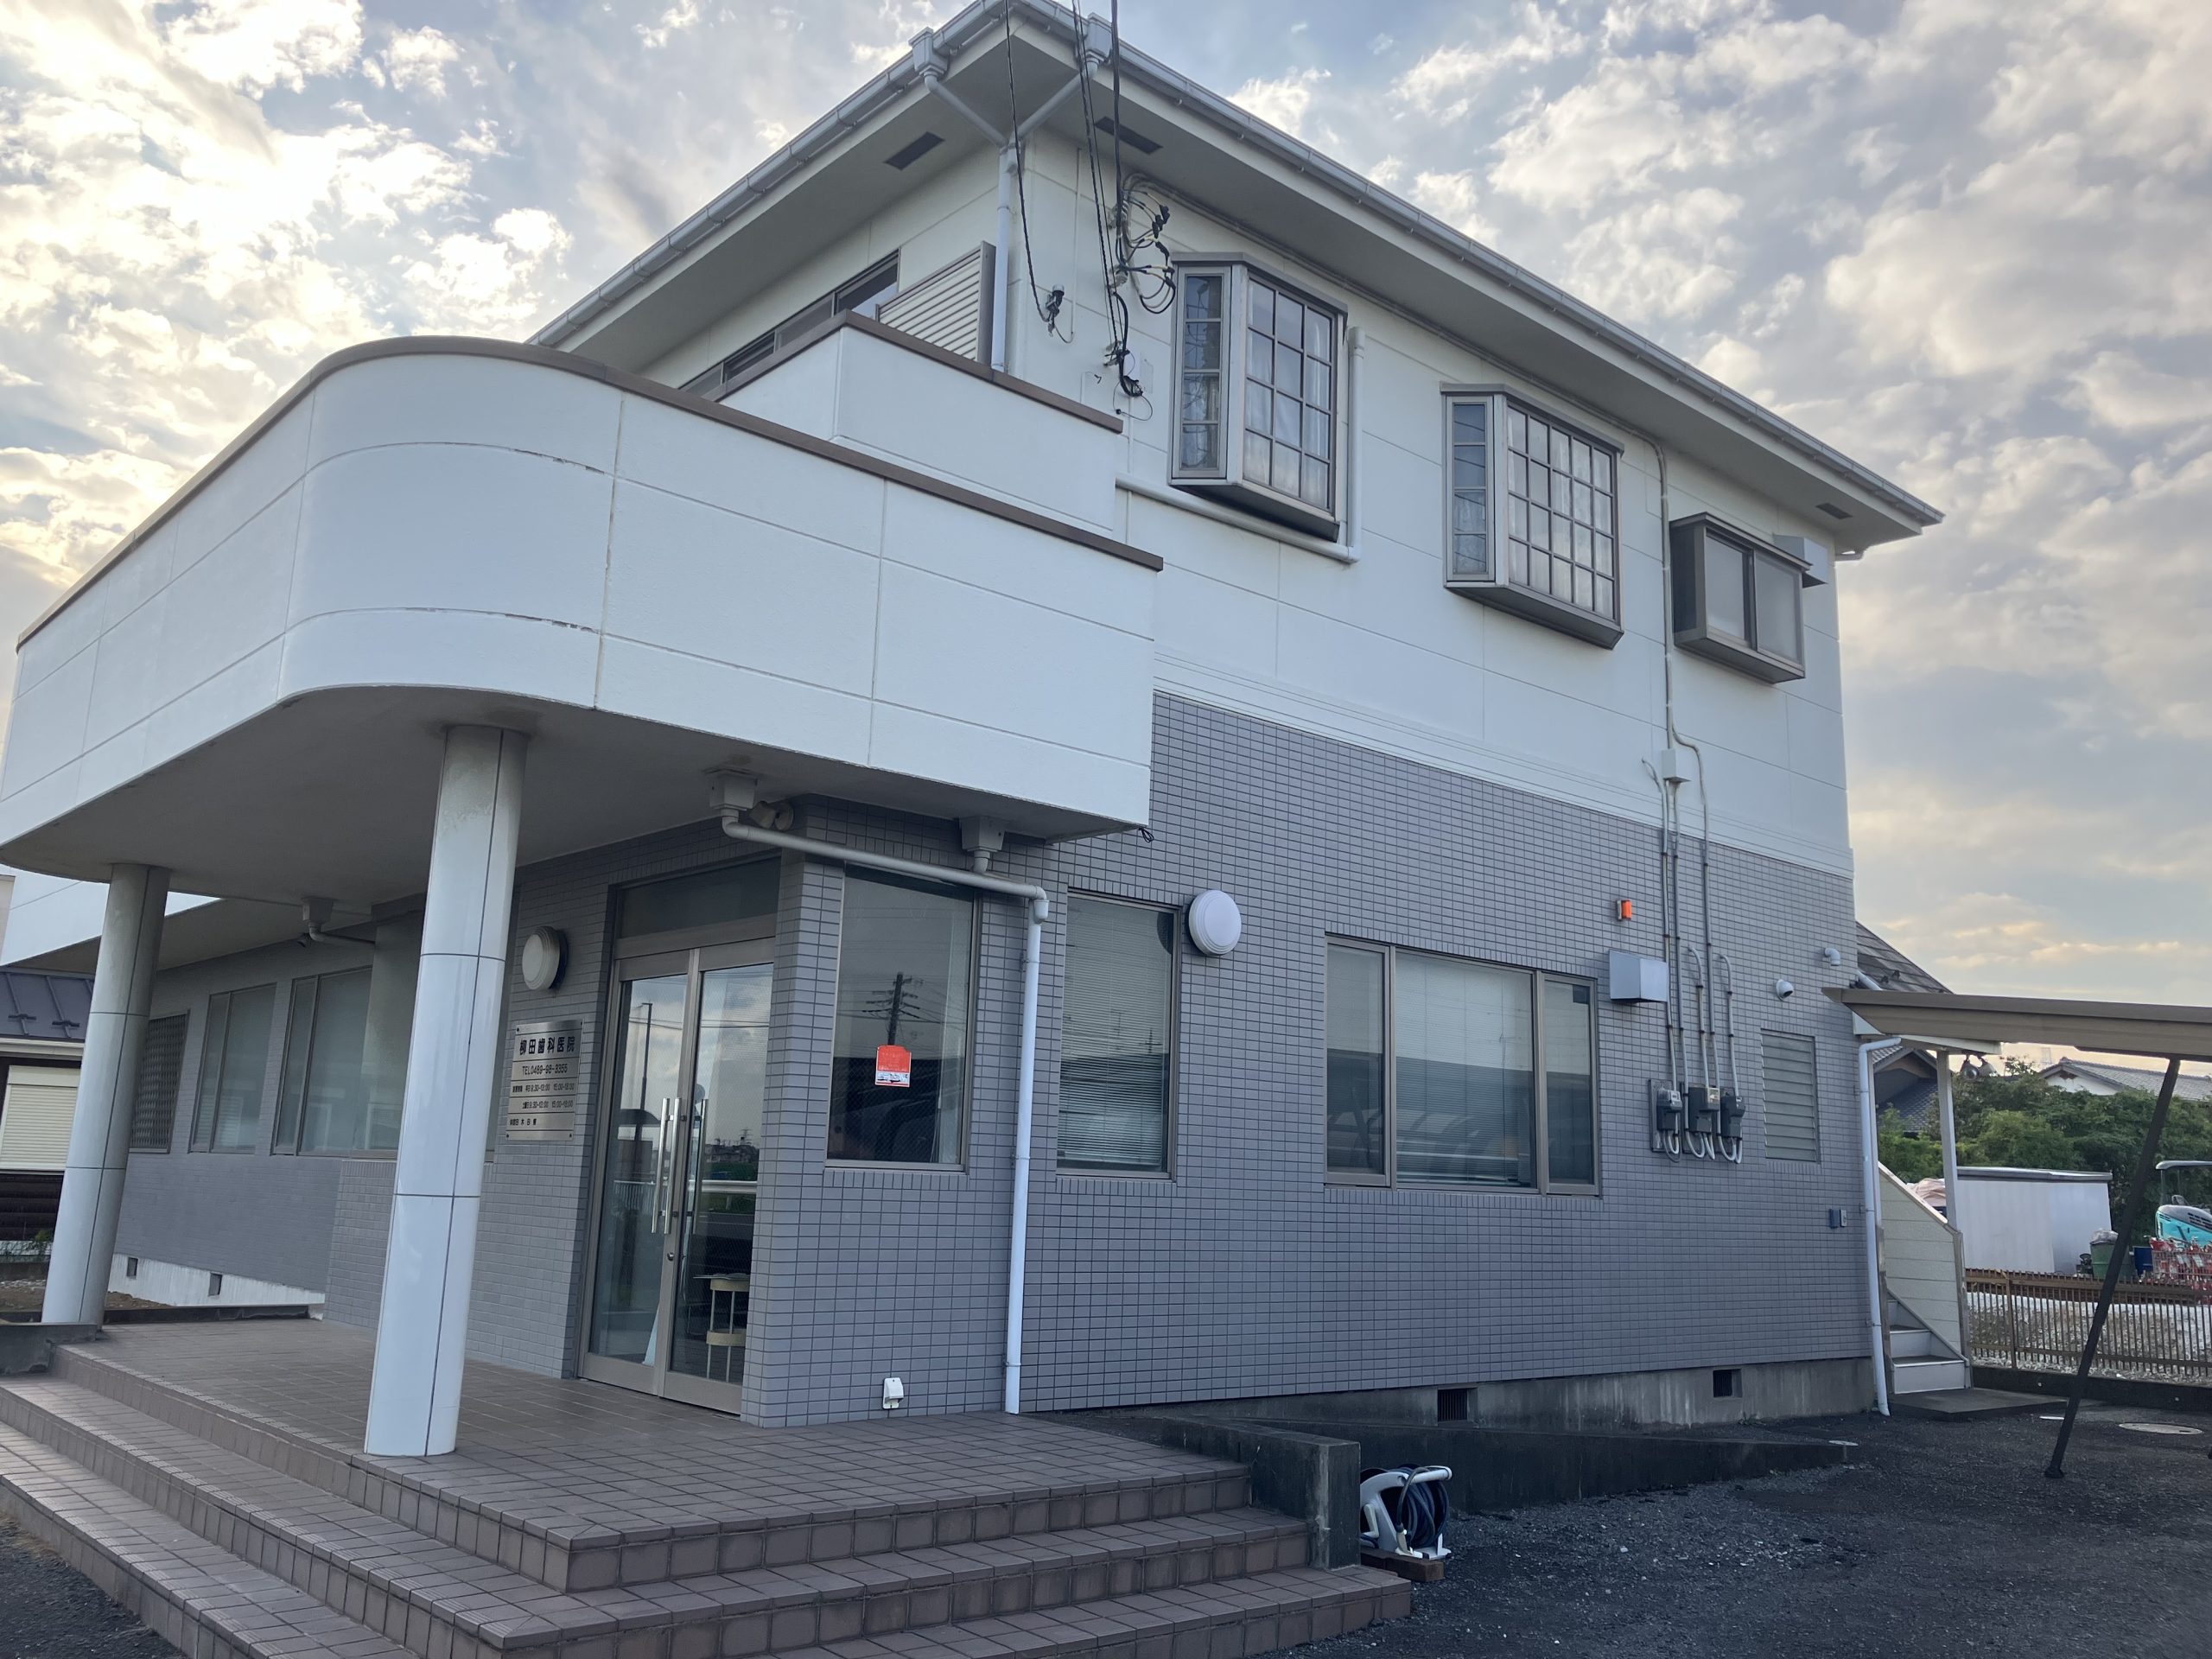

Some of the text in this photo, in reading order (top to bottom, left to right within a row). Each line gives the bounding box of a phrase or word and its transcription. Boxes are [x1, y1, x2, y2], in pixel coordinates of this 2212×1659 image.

[519, 1036, 575, 1055] 柳田歯科医院
